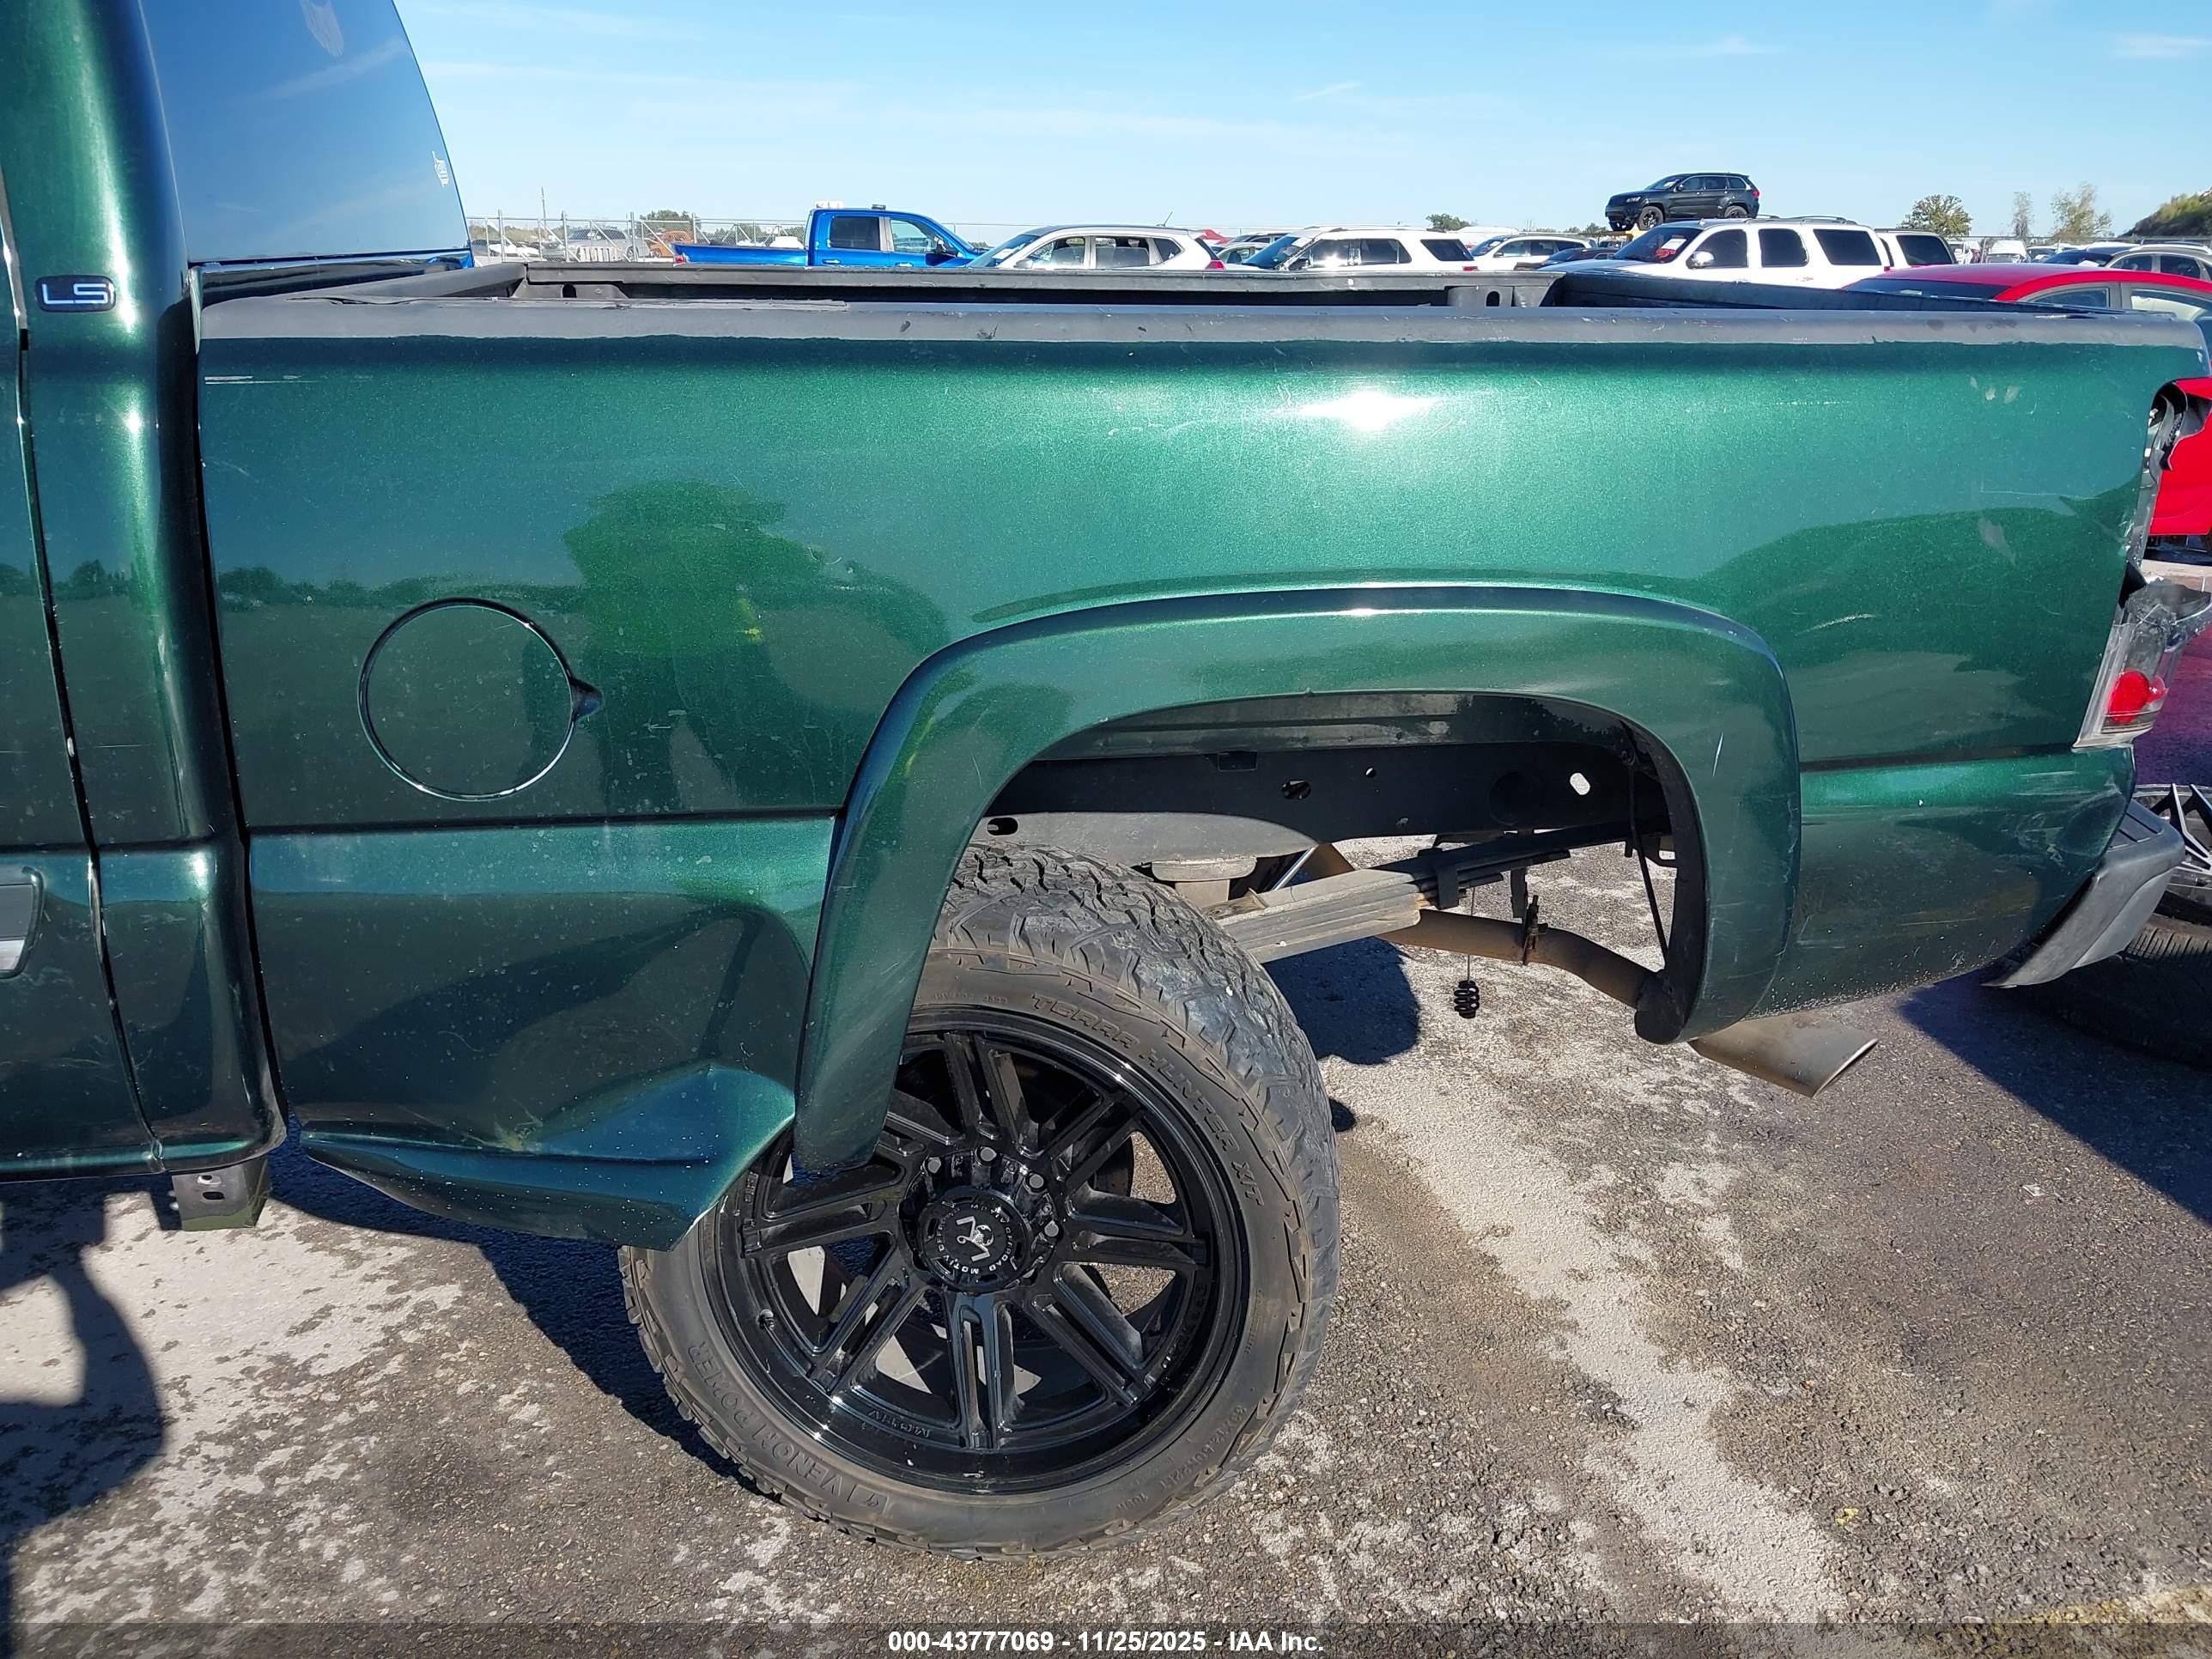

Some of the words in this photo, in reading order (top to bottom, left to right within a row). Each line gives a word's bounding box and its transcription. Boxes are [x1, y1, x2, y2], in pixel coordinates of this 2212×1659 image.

[41, 283, 109, 305] LS
[1139, 1048, 1240, 1152] HUNTER
[943, 1255, 980, 1275] MOTIV
[688, 1340, 754, 1429] POWER
[750, 1422, 843, 1496] VENOM
